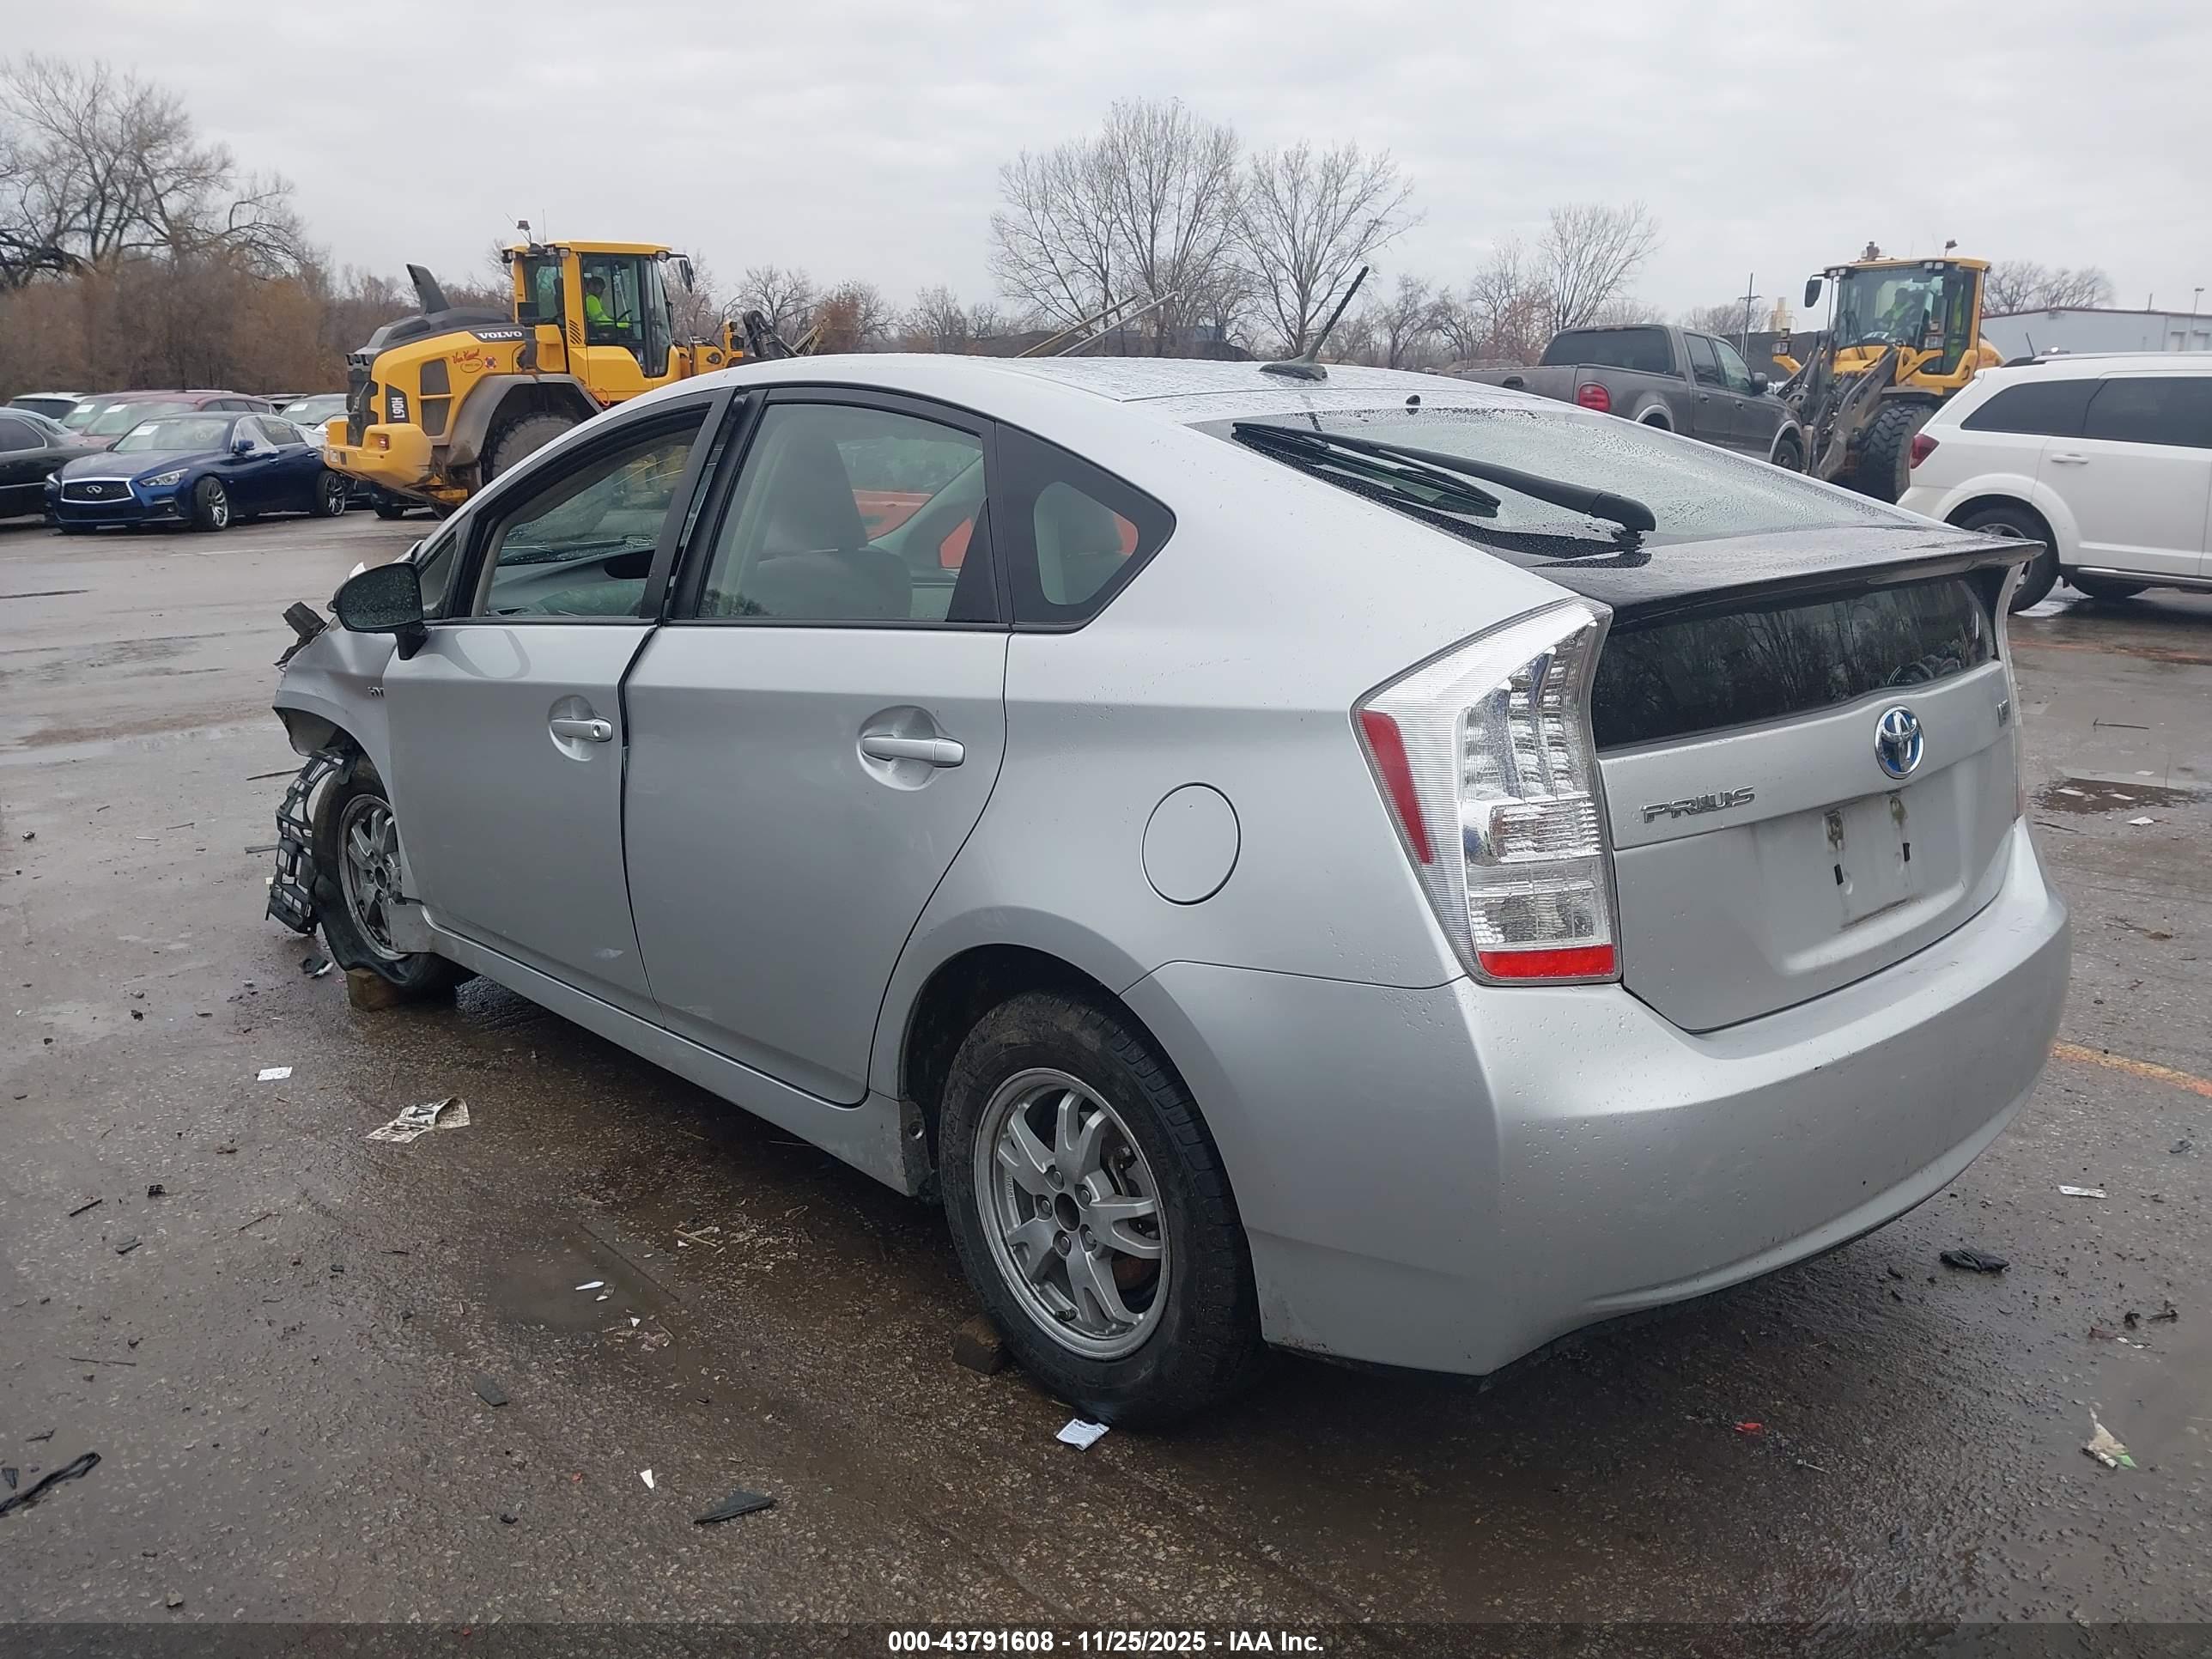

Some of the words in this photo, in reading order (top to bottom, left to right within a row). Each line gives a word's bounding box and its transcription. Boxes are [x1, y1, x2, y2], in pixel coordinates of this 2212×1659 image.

[477, 331, 523, 339] VOLVO
[391, 397, 406, 419] L90H
[1639, 785, 1755, 823] PRIUS
